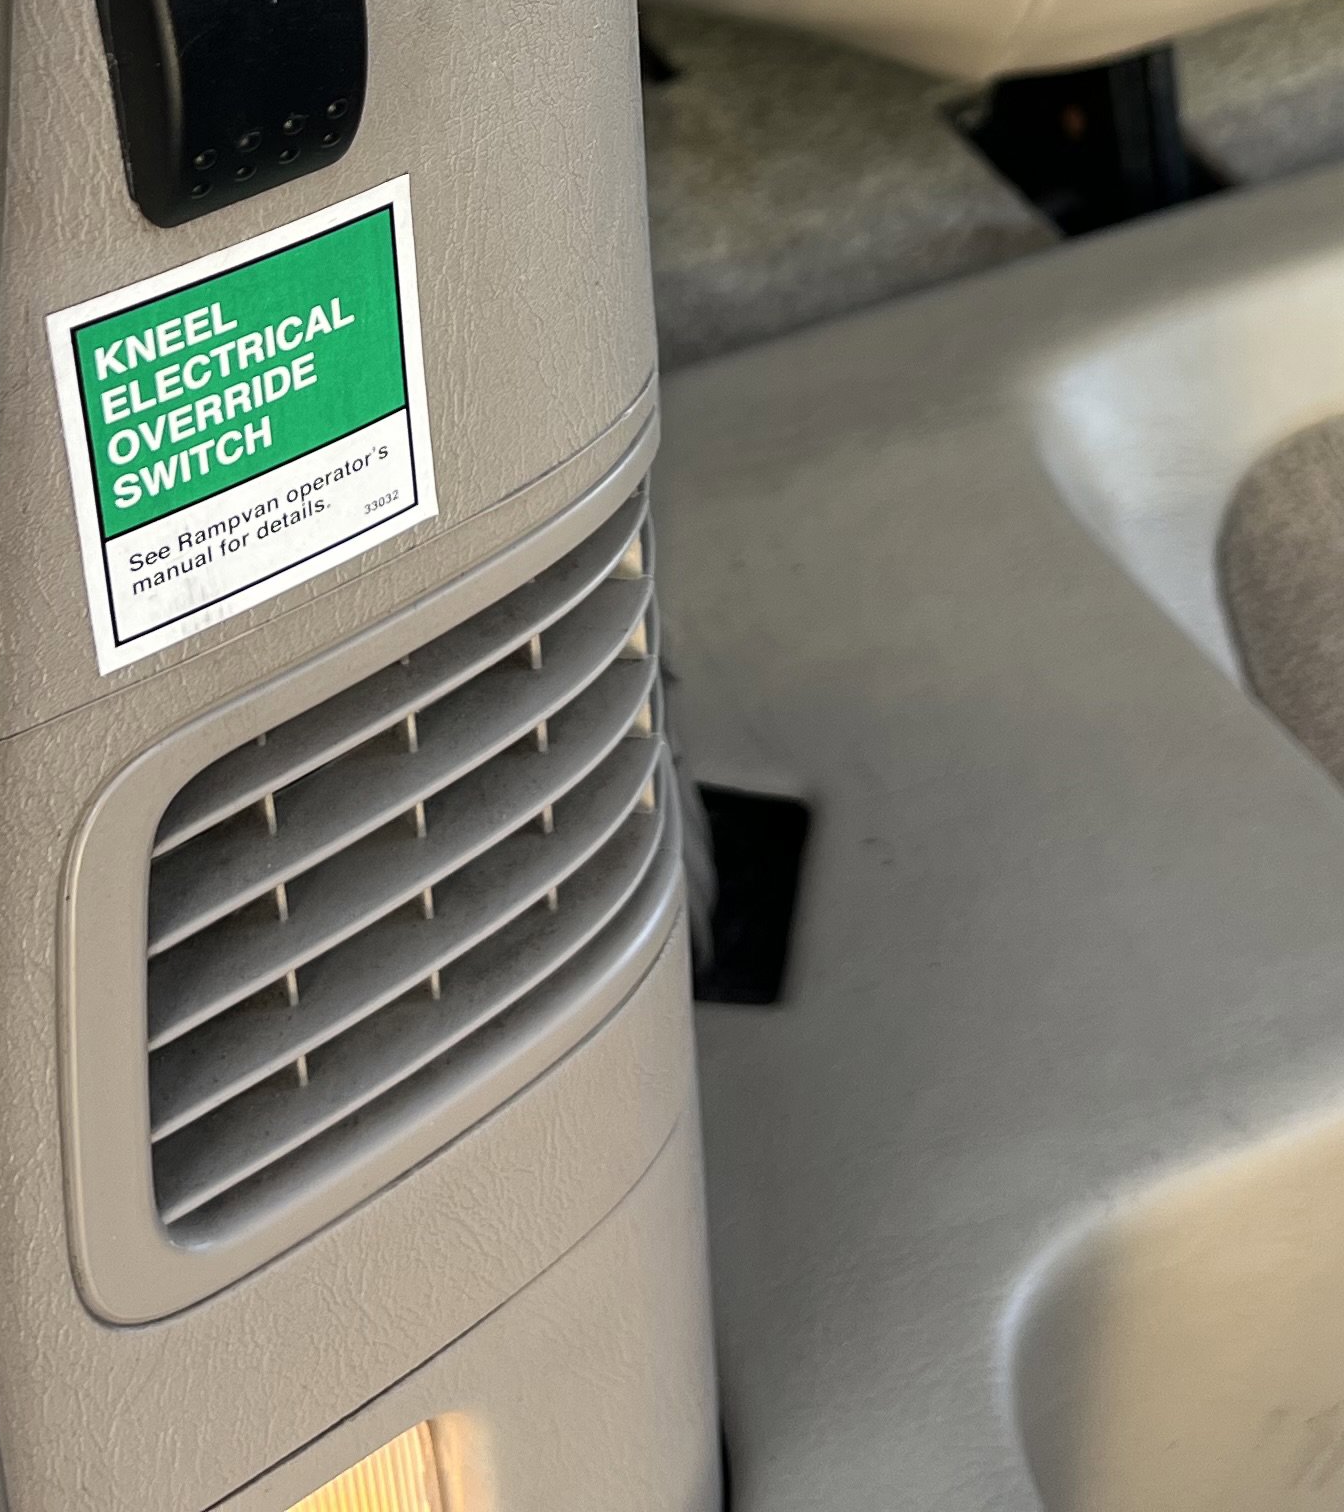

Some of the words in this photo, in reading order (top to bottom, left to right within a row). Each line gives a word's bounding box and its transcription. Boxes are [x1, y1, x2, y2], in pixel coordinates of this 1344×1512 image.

[94, 302, 238, 381] KNEEL
[101, 297, 355, 425] ELECTRICAL
[107, 352, 318, 465] OVERRIDE
[112, 415, 273, 509] SWITCH
[129, 545, 171, 572] See
[178, 497, 279, 552] Rampvan
[286, 445, 389, 504] operator's
[364, 489, 400, 515] 33032
[132, 546, 213, 595] manual
[220, 533, 250, 557] for
[256, 498, 332, 539] details.
